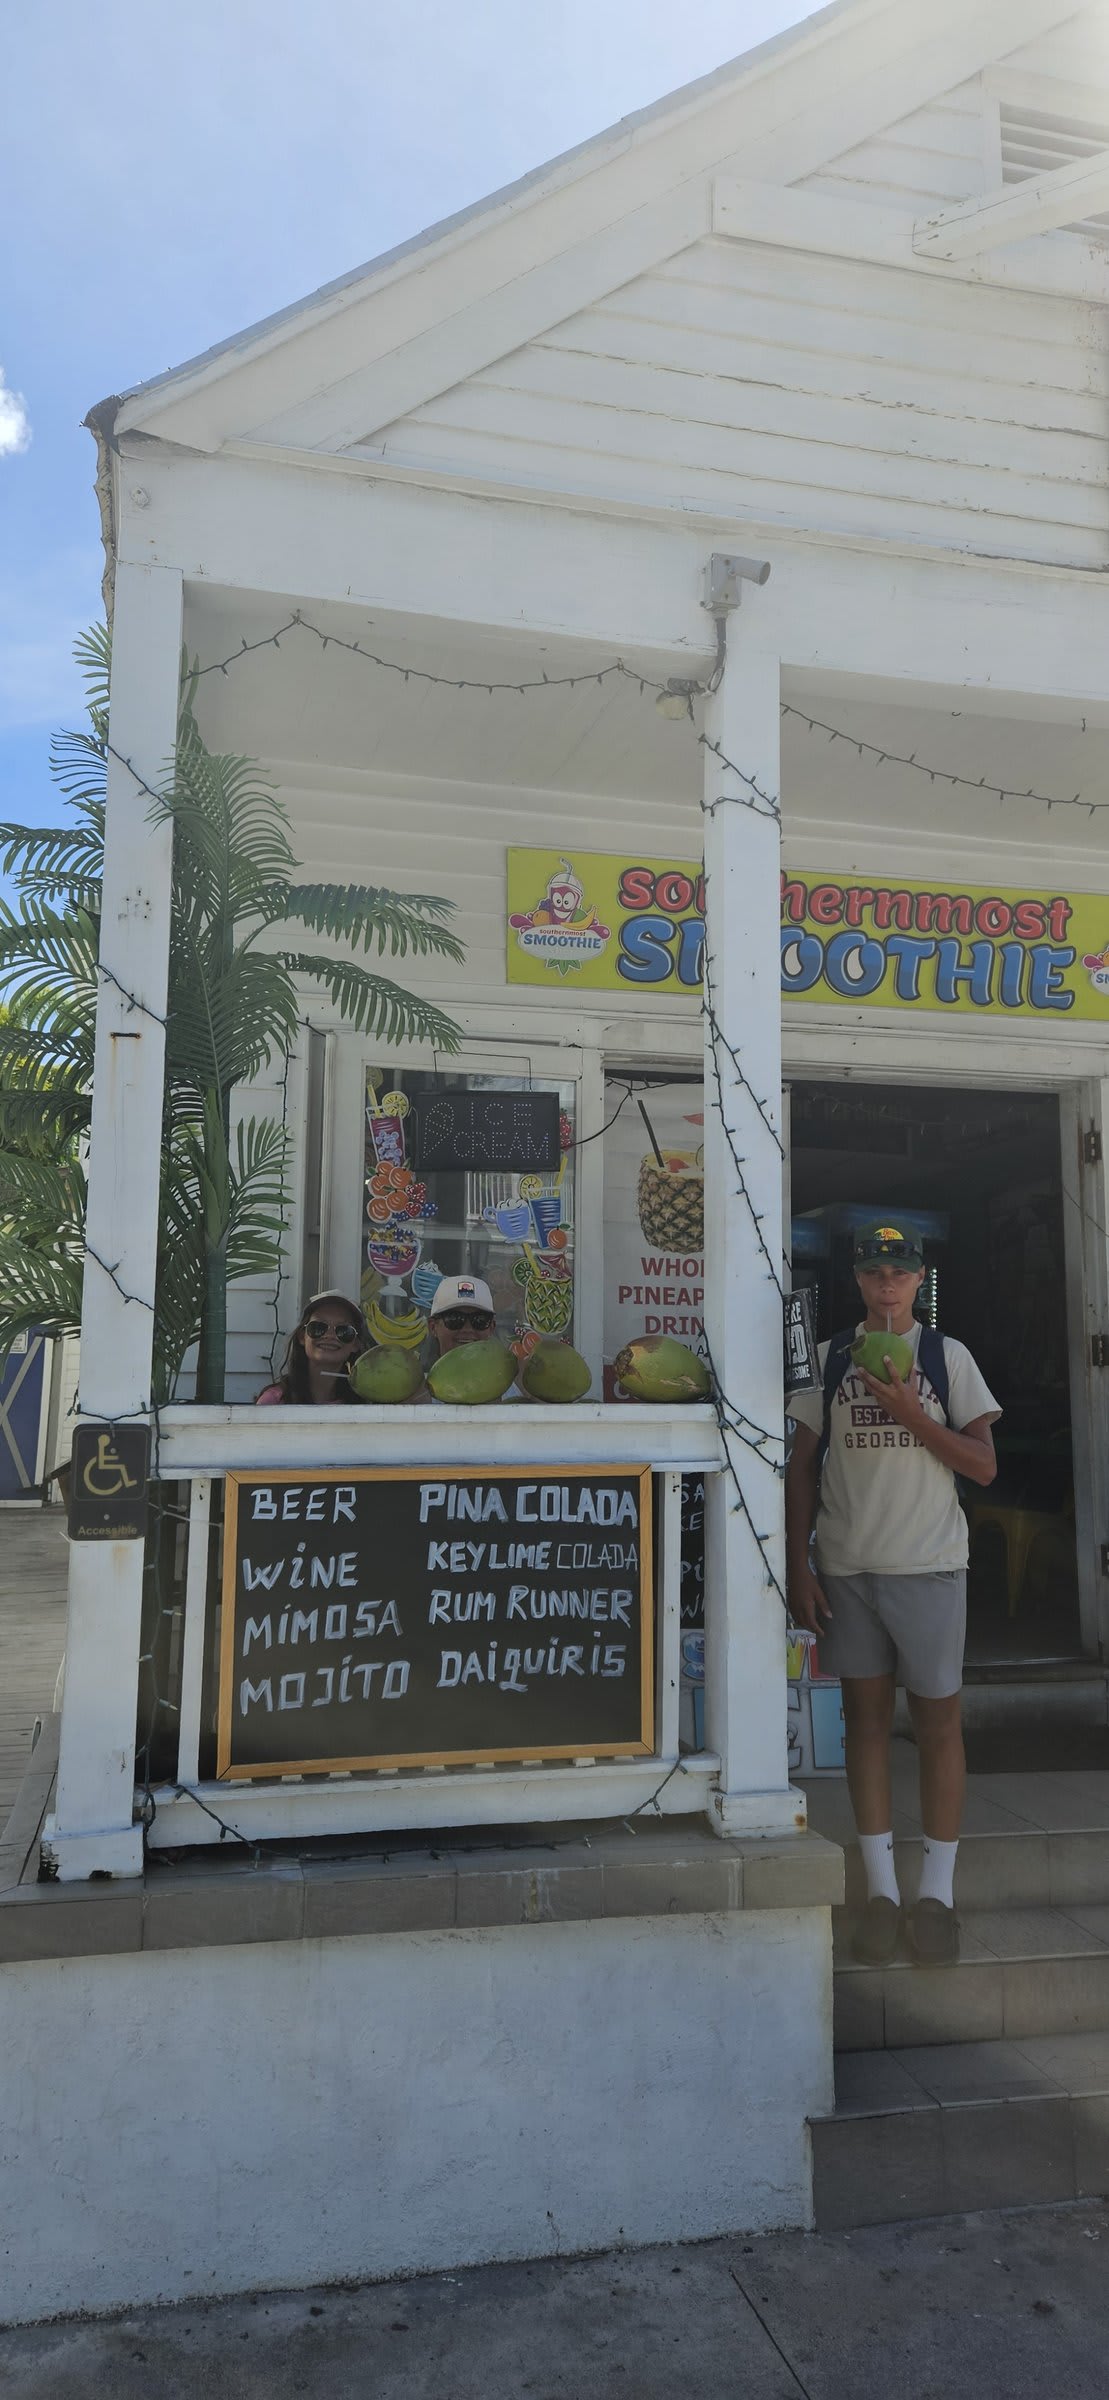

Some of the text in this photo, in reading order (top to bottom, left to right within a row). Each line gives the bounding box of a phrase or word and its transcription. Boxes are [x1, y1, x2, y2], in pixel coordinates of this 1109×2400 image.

[618, 867, 1072, 942] sohernmost
[523, 934, 602, 949] SMOOTHIE
[539, 929, 586, 937] southernmost
[617, 914, 1076, 1010] SOOTHIE
[470, 1101, 533, 1127] ICE
[453, 1131, 549, 1159] CREAM
[641, 1257, 704, 1277] WHO
[619, 1285, 704, 1306] PINEAP
[645, 1316, 704, 1335] DRIN
[251, 1487, 357, 1524] BEER
[419, 1484, 638, 1529] PINA COLADA
[78, 1525, 137, 1536] Accessible
[427, 1541, 638, 1573] KEY LIME COLADA
[428, 1585, 633, 1628] RUM RUNNER
